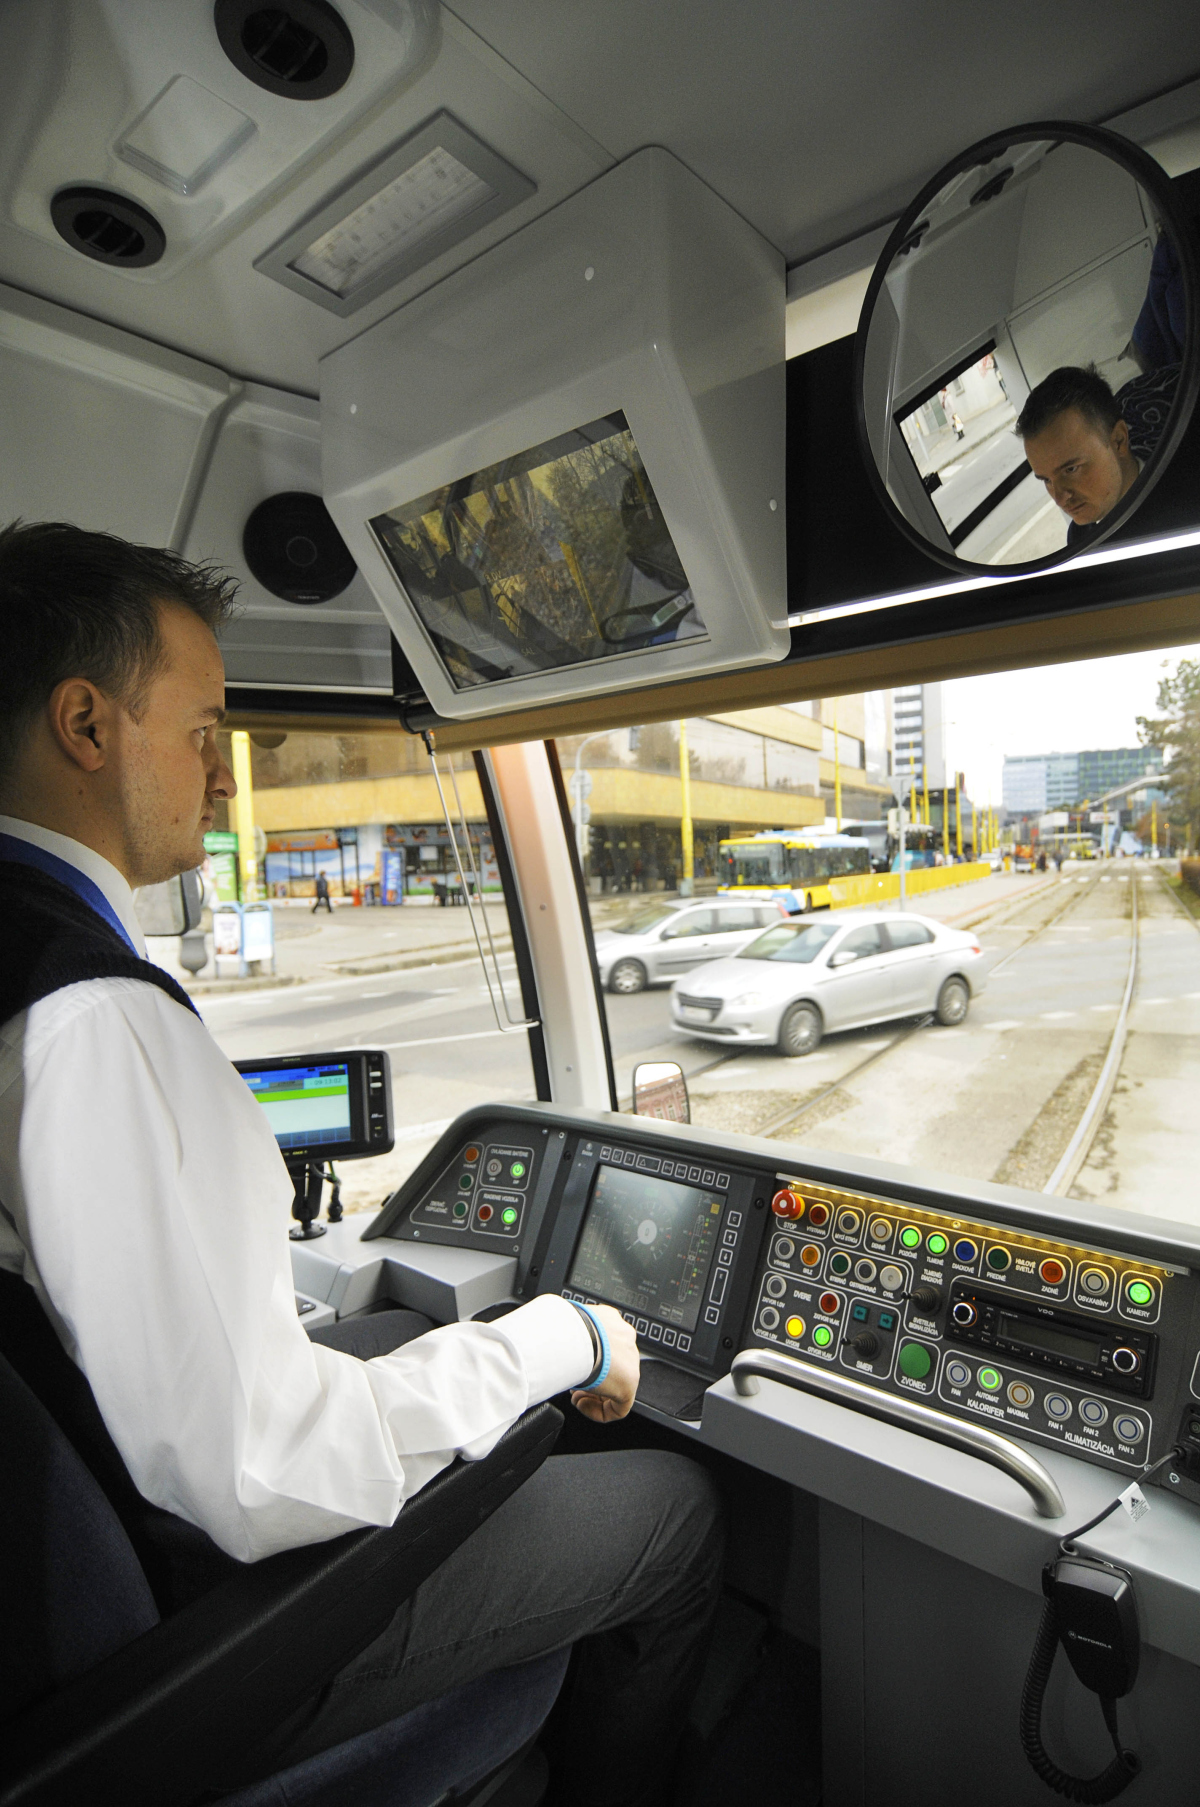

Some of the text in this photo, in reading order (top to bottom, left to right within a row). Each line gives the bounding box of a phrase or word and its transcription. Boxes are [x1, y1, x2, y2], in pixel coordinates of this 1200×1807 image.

[783, 1221, 797, 1230] STOP
[793, 1289, 812, 1302] DVERE
[1037, 1307, 1054, 1316] VDO
[1126, 1306, 1151, 1319] KAMERY
[855, 1360, 873, 1372] SMER
[901, 1376, 927, 1391] ZVONEC
[950, 1388, 962, 1397] FAN
[975, 1390, 999, 1403] AUTOMAT
[966, 1397, 1005, 1418] KALORIFER
[1006, 1406, 1030, 1420] MAXIMAL
[1048, 1420, 1059, 1430] FAN
[1083, 1425, 1094, 1435] FAN
[1064, 1431, 1115, 1456] KLIMATIZÁCIA
[1118, 1443, 1130, 1453] FAN
[1077, 1634, 1112, 1649] MOTOROLA
